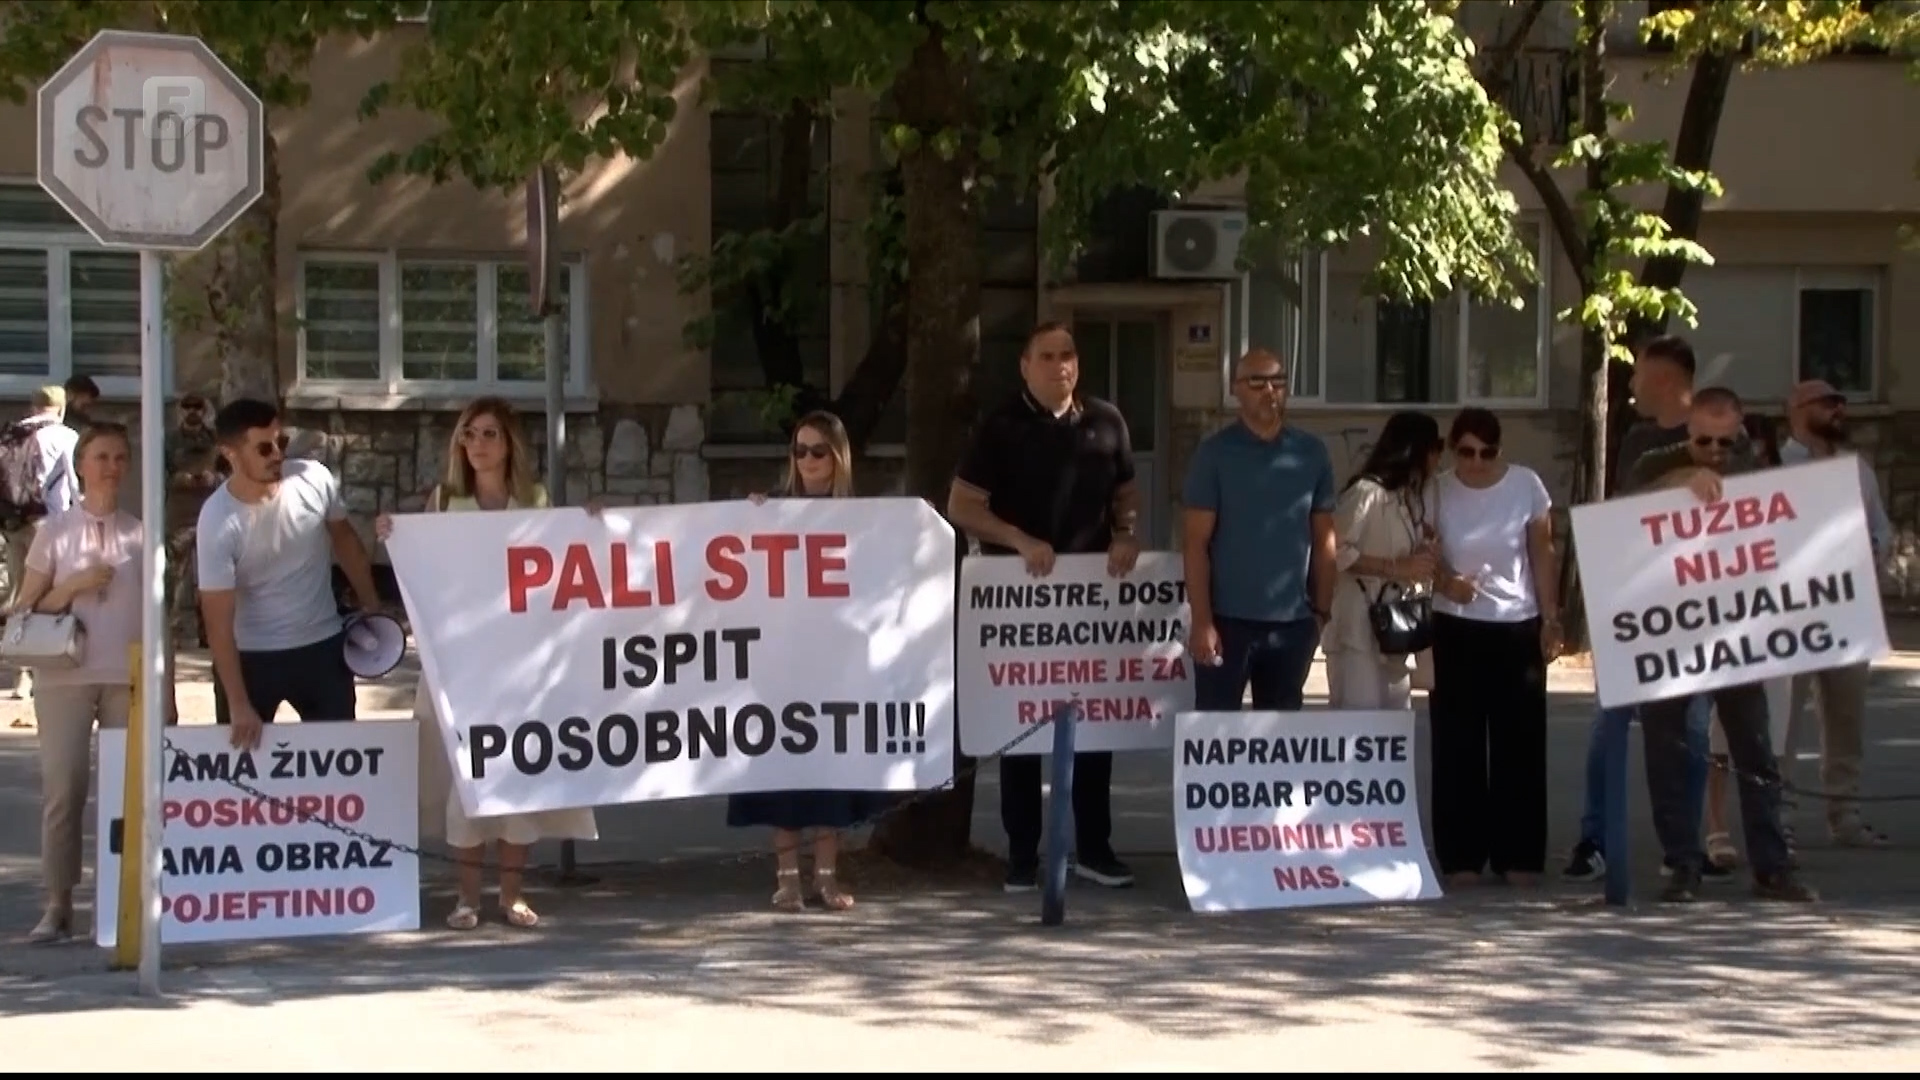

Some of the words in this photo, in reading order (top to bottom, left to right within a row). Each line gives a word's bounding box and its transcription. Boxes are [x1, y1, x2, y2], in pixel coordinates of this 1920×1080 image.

[74, 105, 229, 174] STOP
[507, 541, 676, 613] PALI
[705, 533, 850, 601] STE
[1674, 539, 1779, 586] NIJE
[971, 583, 1109, 610] MINISTRE,
[1118, 580, 1186, 604] DOST
[1612, 571, 1855, 642] SOCIJALNI
[980, 618, 1183, 647] PREBACIVANJA
[602, 628, 761, 690] ISPIT
[1635, 621, 1848, 684] DIJALOG.
[988, 658, 1108, 687] VRIJEME
[1115, 658, 1144, 682] JE
[1151, 657, 1187, 681] ZA
[457, 702, 926, 778] POSOBNOSTI!!!
[1183, 736, 1346, 765] NAPRAVILI
[1355, 736, 1407, 763] STE
[167, 753, 258, 782] AMA
[270, 741, 384, 779] ŽIVOT
[163, 794, 365, 828] POSKUPIO
[1186, 780, 1293, 809] DOBAR
[1304, 778, 1406, 807] POSAO
[1195, 823, 1342, 853] UJEDINILI
[1351, 822, 1407, 848] STE
[163, 845, 243, 876] AMA
[256, 840, 393, 872] OBRAZ
[1273, 865, 1351, 891] NAS.
